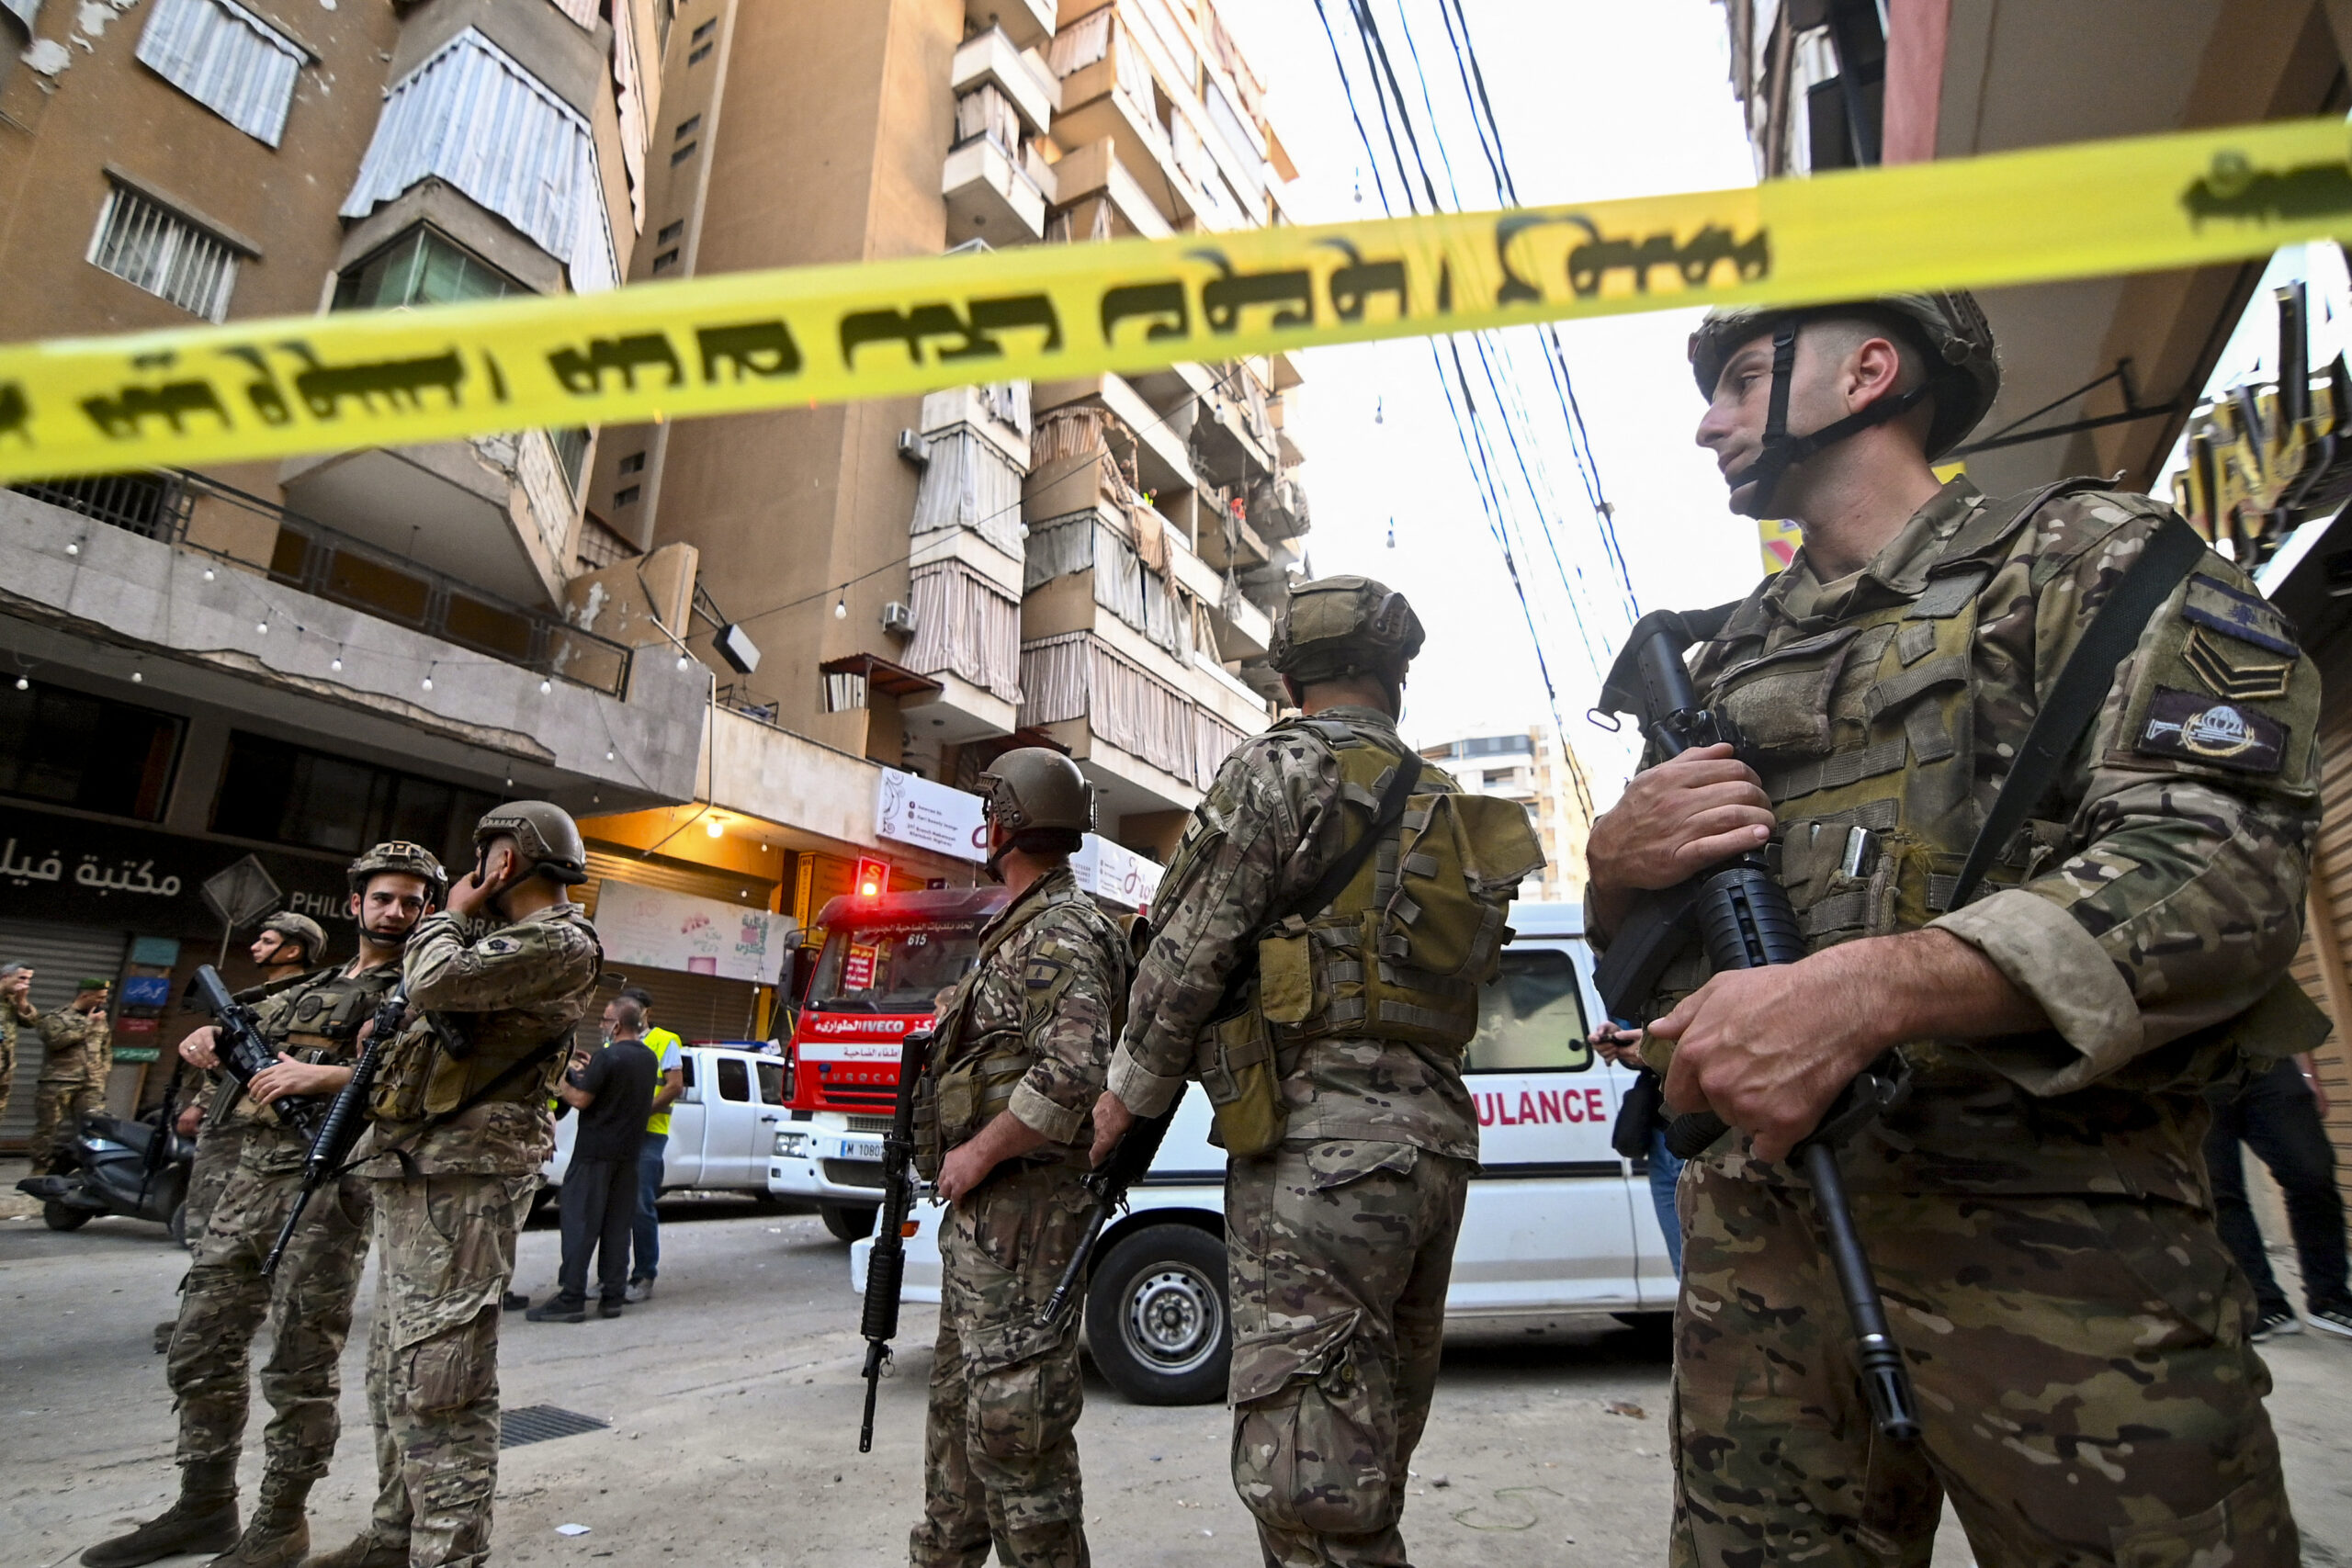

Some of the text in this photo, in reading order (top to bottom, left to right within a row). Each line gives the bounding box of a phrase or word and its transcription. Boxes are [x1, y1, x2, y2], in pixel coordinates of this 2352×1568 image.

[75, 854, 181, 897] مكتبة
[907, 933, 928, 946] 615
[862, 1020, 905, 1032] IVECO
